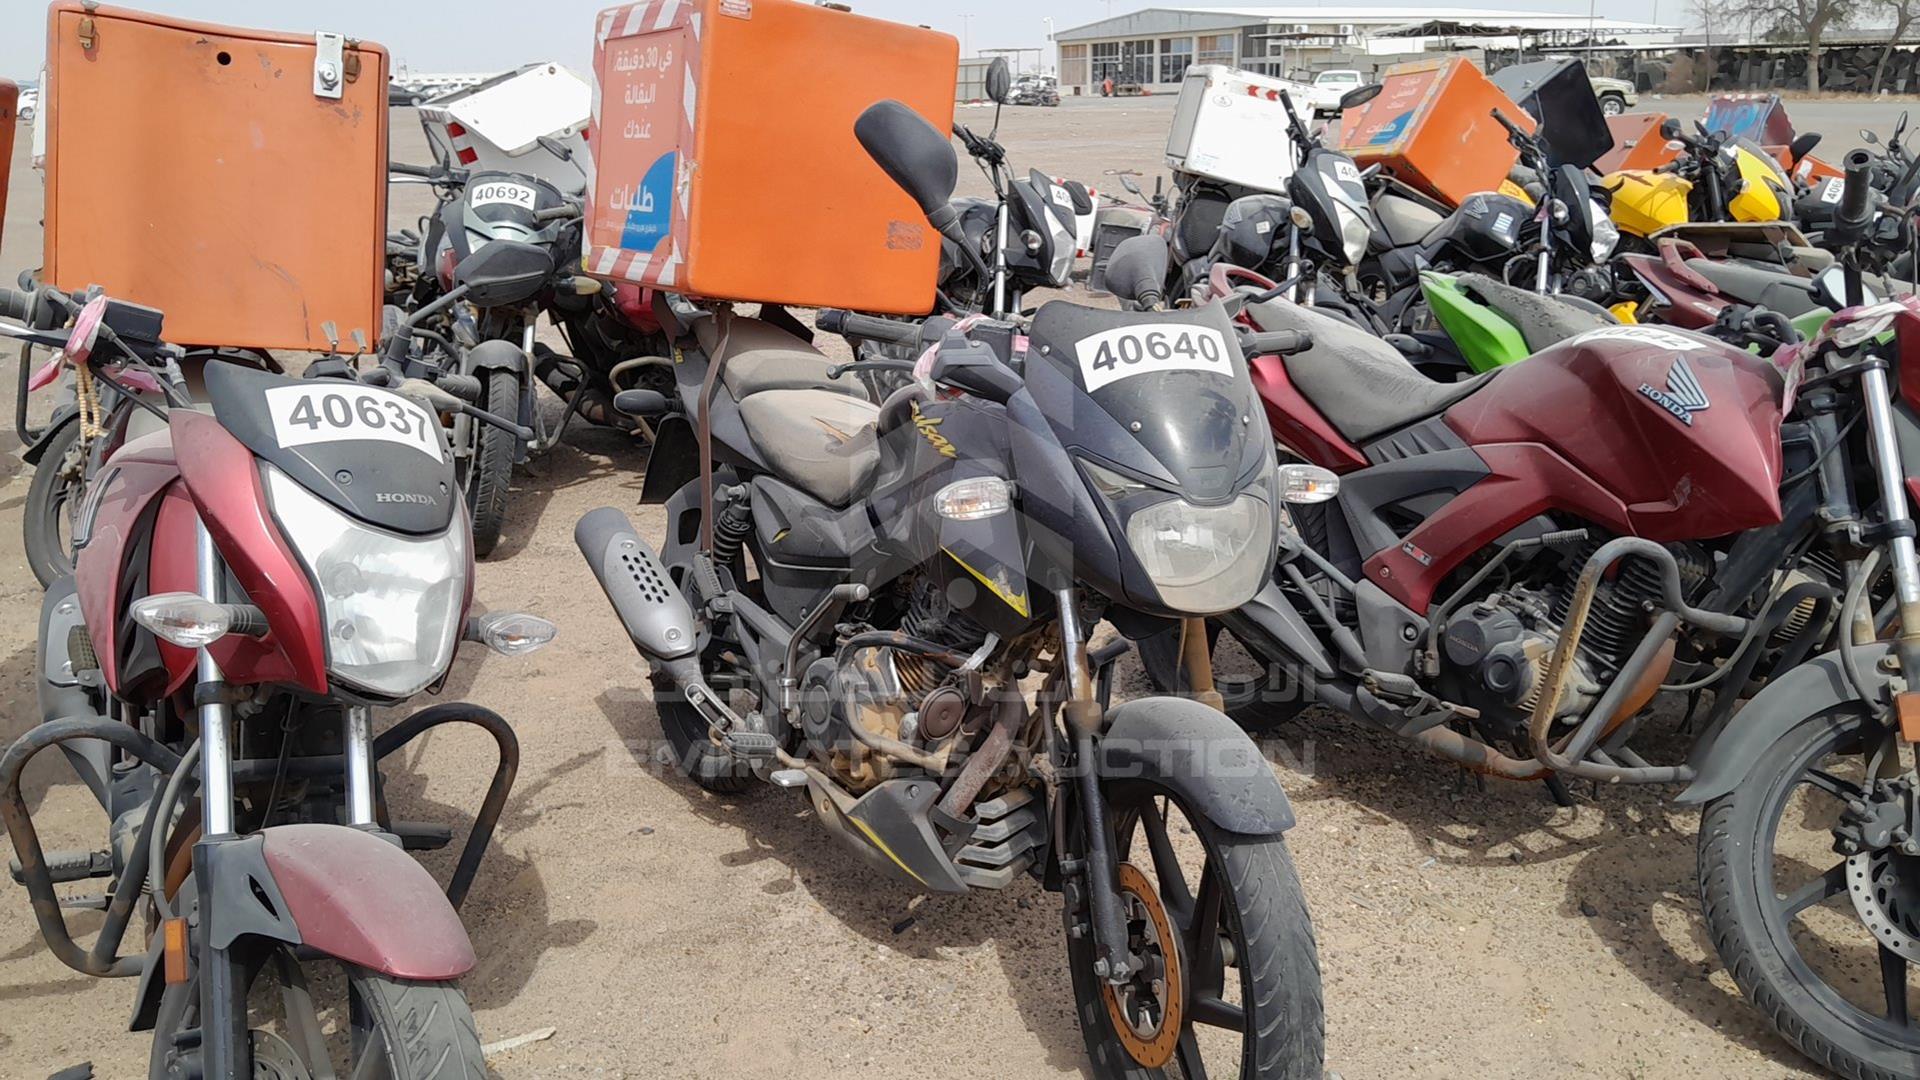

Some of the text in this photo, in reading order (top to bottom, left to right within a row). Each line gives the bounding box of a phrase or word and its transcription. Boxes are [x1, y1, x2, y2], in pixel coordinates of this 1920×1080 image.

[646, 46, 658, 68] 30
[659, 43, 672, 79] في
[625, 83, 656, 110] البقالة
[475, 186, 530, 204] 40692
[610, 183, 654, 219] طلبات
[1092, 331, 1220, 371] 40640
[289, 393, 427, 443] 40637
[1638, 383, 1693, 425] HONDA
[375, 493, 438, 505] HONDA
